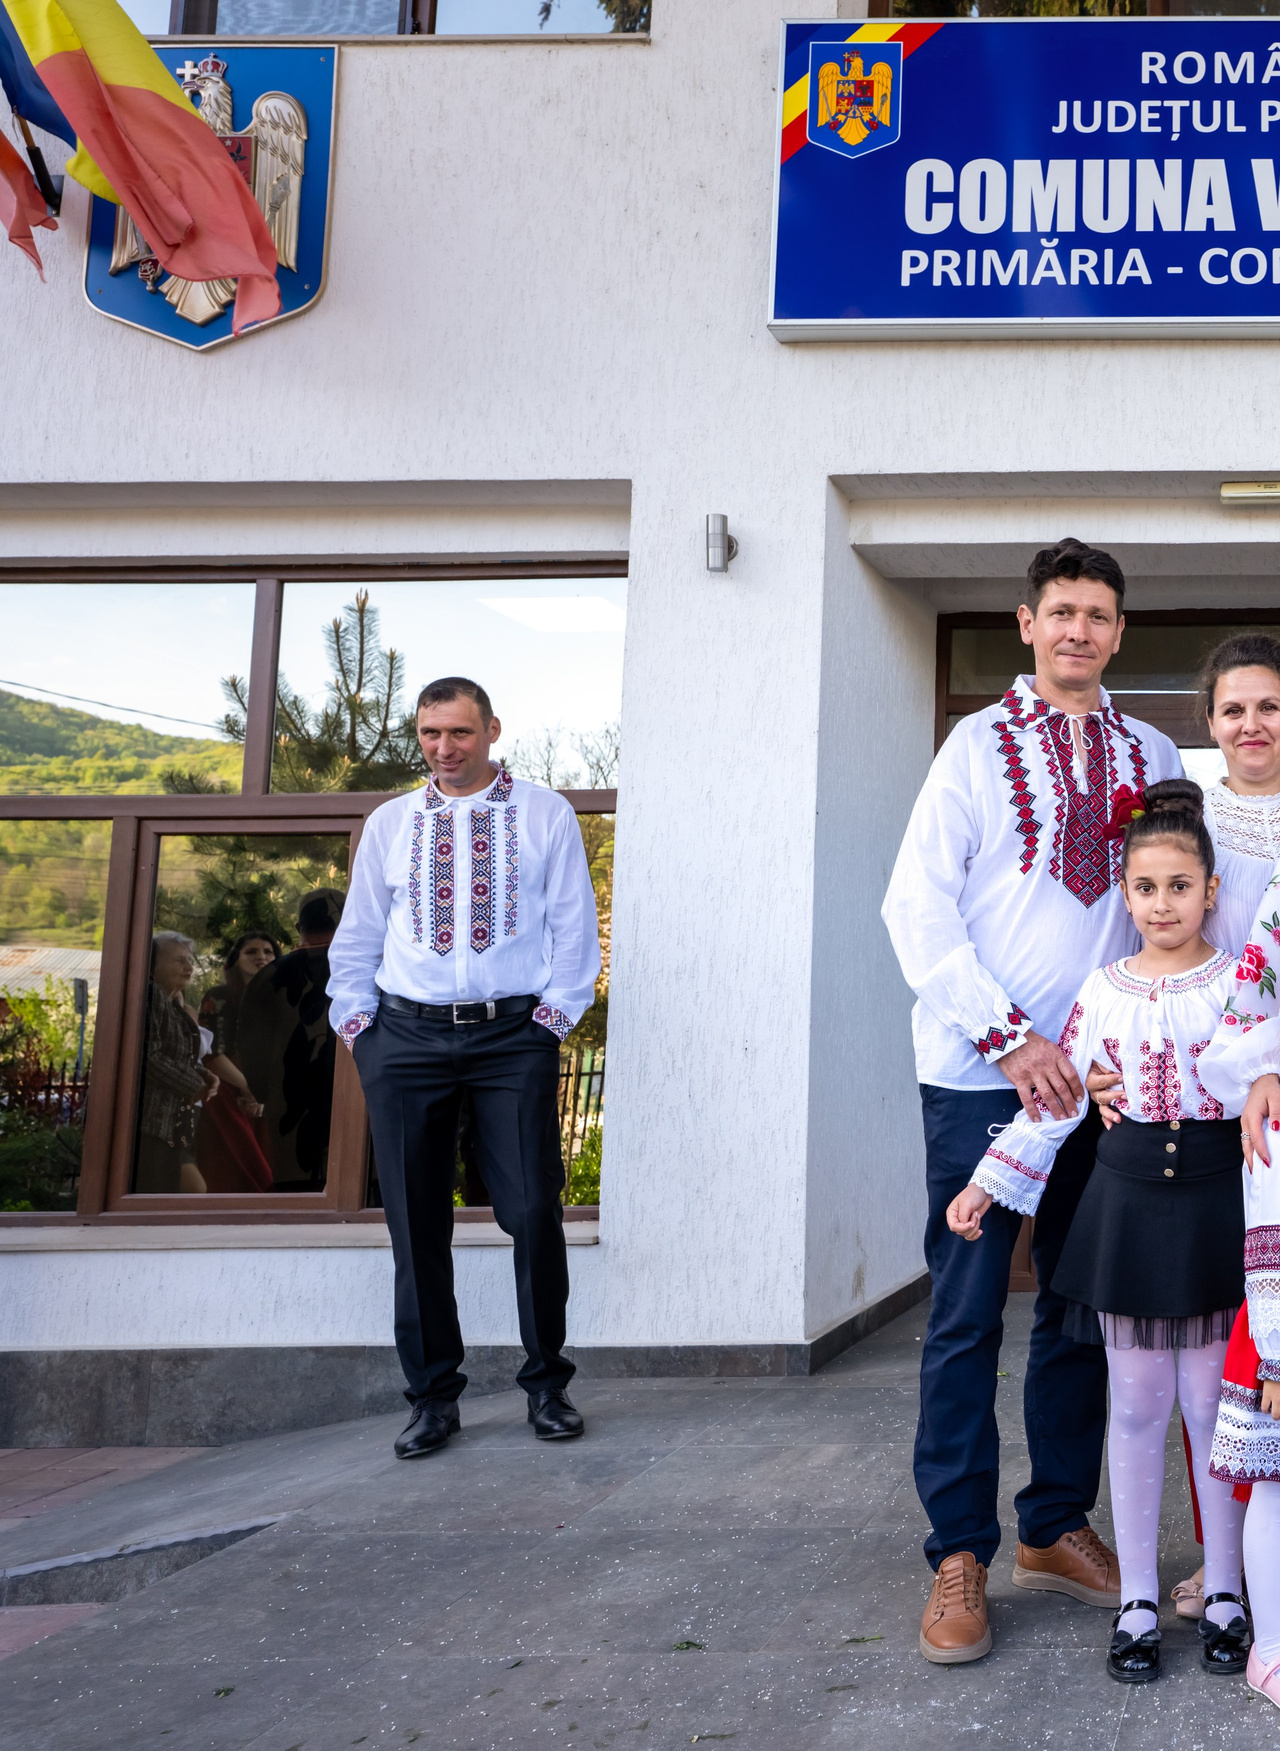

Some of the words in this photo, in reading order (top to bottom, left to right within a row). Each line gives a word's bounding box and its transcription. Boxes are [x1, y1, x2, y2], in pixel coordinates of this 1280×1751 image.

[1051, 100, 1247, 141] JUDEȚUL
[904, 158, 1236, 235] COMUNA
[900, 238, 1153, 287] PRIMĂRIA
